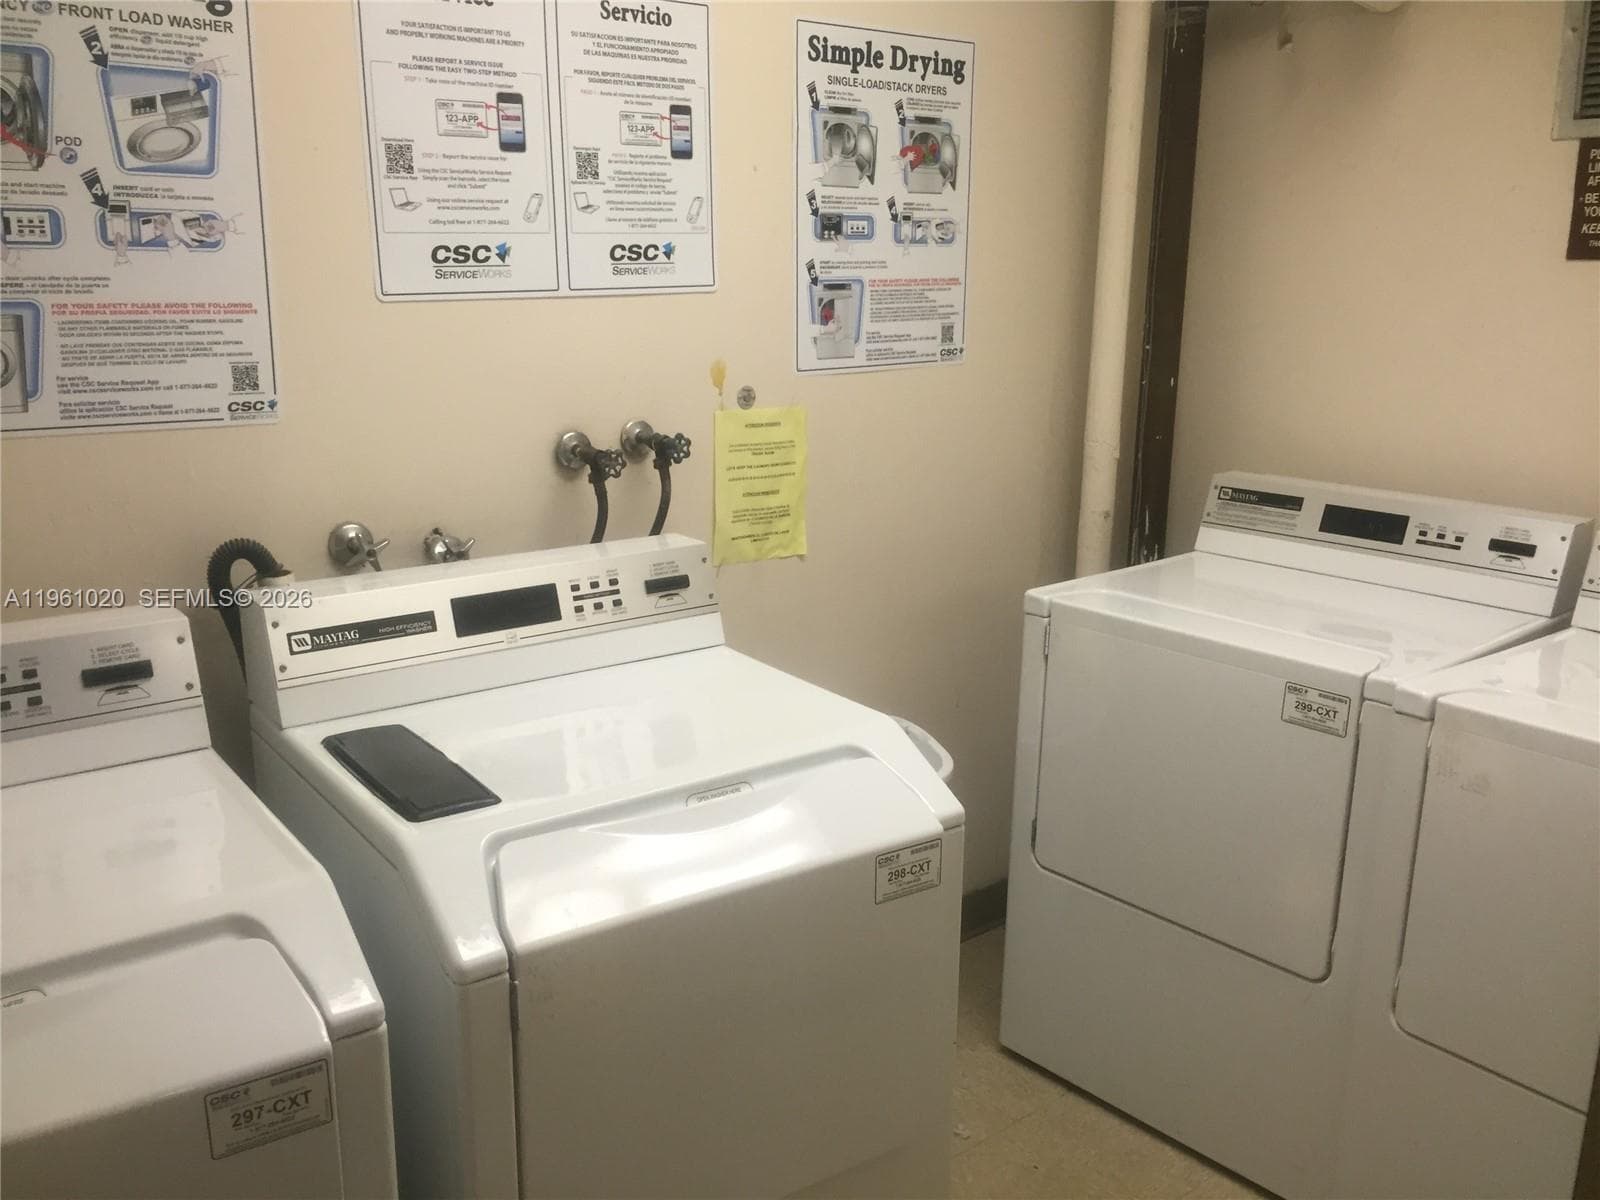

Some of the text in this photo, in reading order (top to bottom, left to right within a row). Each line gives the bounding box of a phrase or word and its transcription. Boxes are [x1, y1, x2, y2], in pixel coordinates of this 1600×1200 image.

[57, 3, 114, 20] FRONT
[119, 9, 163, 25] LOAD
[167, 14, 234, 33] WASHER
[600, 0, 672, 27] Servicio
[401, 20, 416, 28] YOUR
[417, 22, 457, 31] SATISFACTION
[463, 26, 495, 35] IMPORTANT
[400, 29, 429, 38] PROPERLY
[429, 32, 457, 41] WORKING
[456, 35, 485, 43] MACHINES
[501, 39, 525, 47] PRIORITY
[579, 31, 617, 41] SATISFACCION
[625, 36, 657, 45] IMPORTANTE
[657, 39, 671, 47] PARA
[671, 41, 697, 50] NOSOTROS
[90, 42, 101, 55] 2
[604, 43, 650, 53] FUNCIONAMIENTO
[650, 47, 680, 56] APROPIADO
[412, 55, 433, 63] PLEASE
[463, 59, 487, 67] SERVICE
[602, 51, 630, 59] MAQUINAS
[637, 54, 660, 62] NUESTRA
[661, 56, 688, 64] PRIORIDAD
[808, 34, 966, 85] Simple Drying
[398, 62, 518, 78] FOLLOWING THE EASY TWO-STEP METHOD
[827, 75, 948, 96] SINGLE-LOAD/STACK DRYERS
[445, 114, 480, 123] 123-APP
[627, 124, 655, 133] 123-APP
[56, 136, 82, 146] POD
[431, 245, 492, 264] CSC
[609, 244, 660, 262] CSC
[940, 347, 958, 356] CSC
[227, 400, 265, 412] CSC
[313, 629, 359, 646] MAYTAG
[1294, 701, 1340, 719] 299-CXT
[887, 860, 932, 882] 298-CXT
[231, 1089, 312, 1128] 297-CXT
